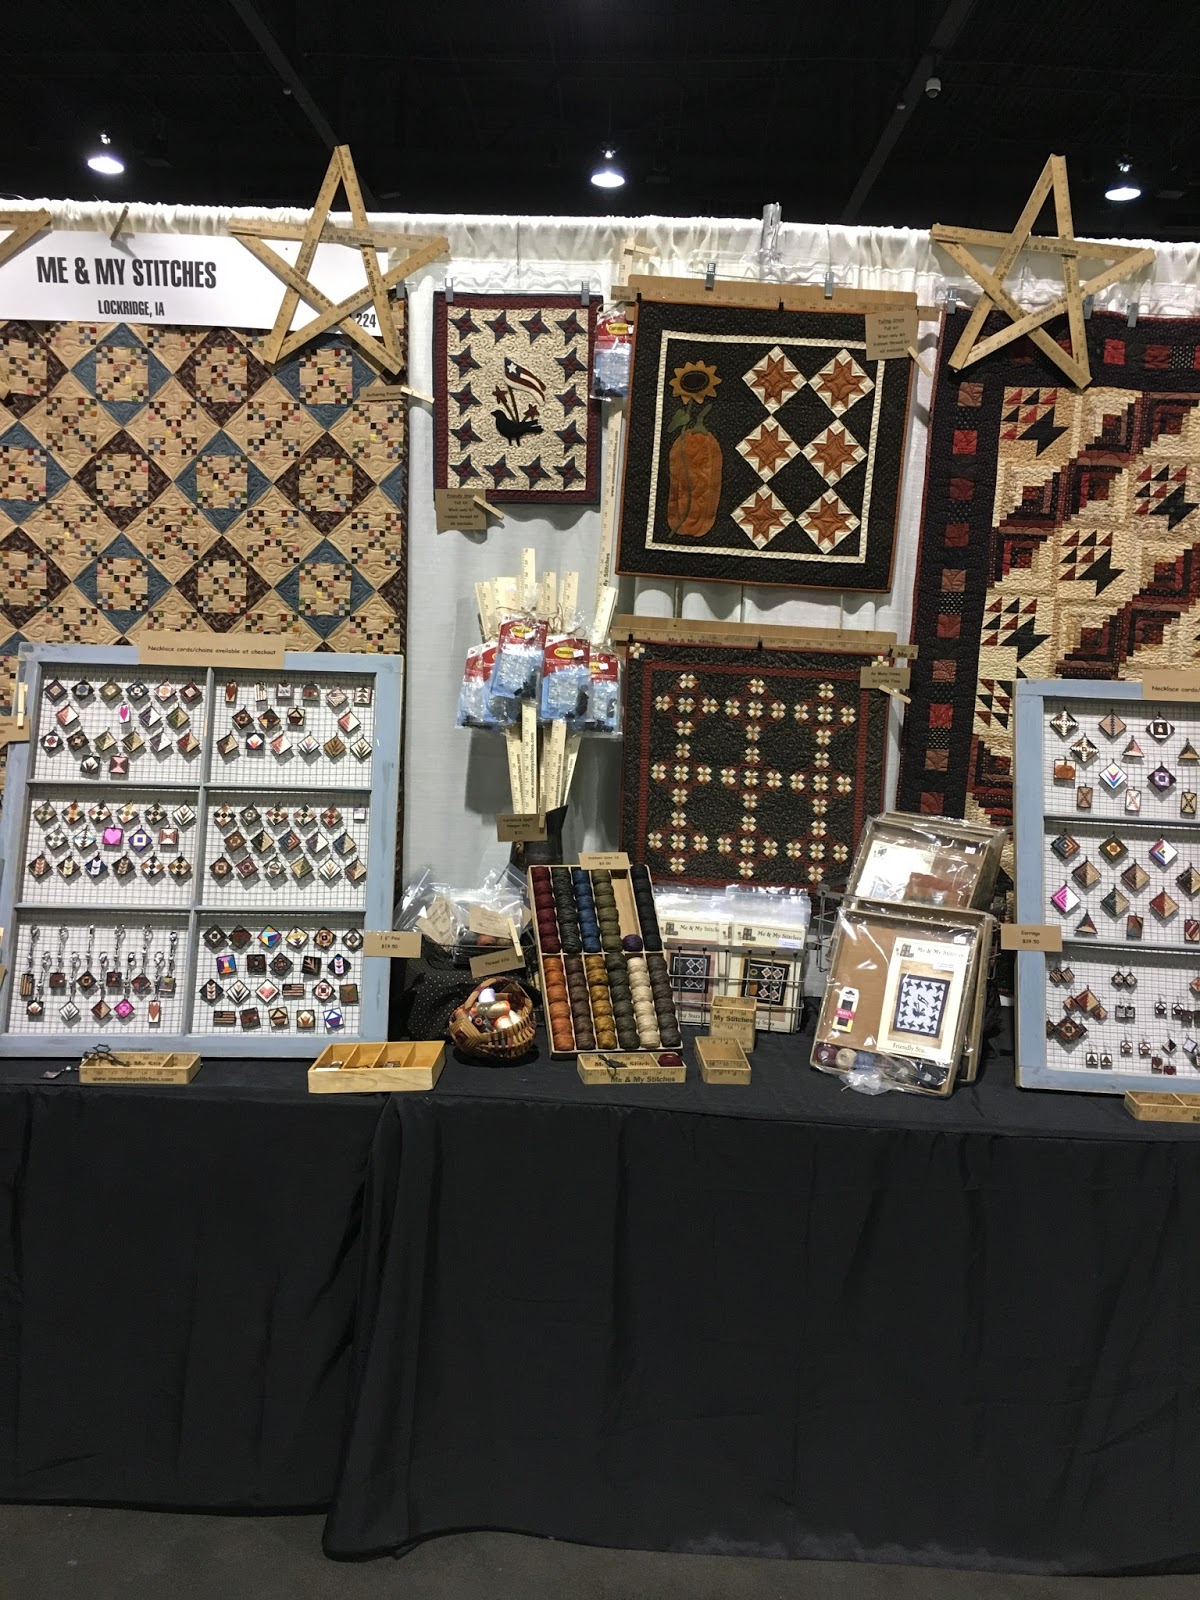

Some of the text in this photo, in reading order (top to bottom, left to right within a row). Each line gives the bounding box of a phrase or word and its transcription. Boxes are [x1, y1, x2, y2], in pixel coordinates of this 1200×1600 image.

[36, 256, 217, 289] ME & MY STITCHES
[98, 300, 165, 318] LOCKRIDGE, IA
[356, 313, 376, 328] 224
[726, 1016, 754, 1024] Stitches
[893, 1042, 914, 1053] Friendly
